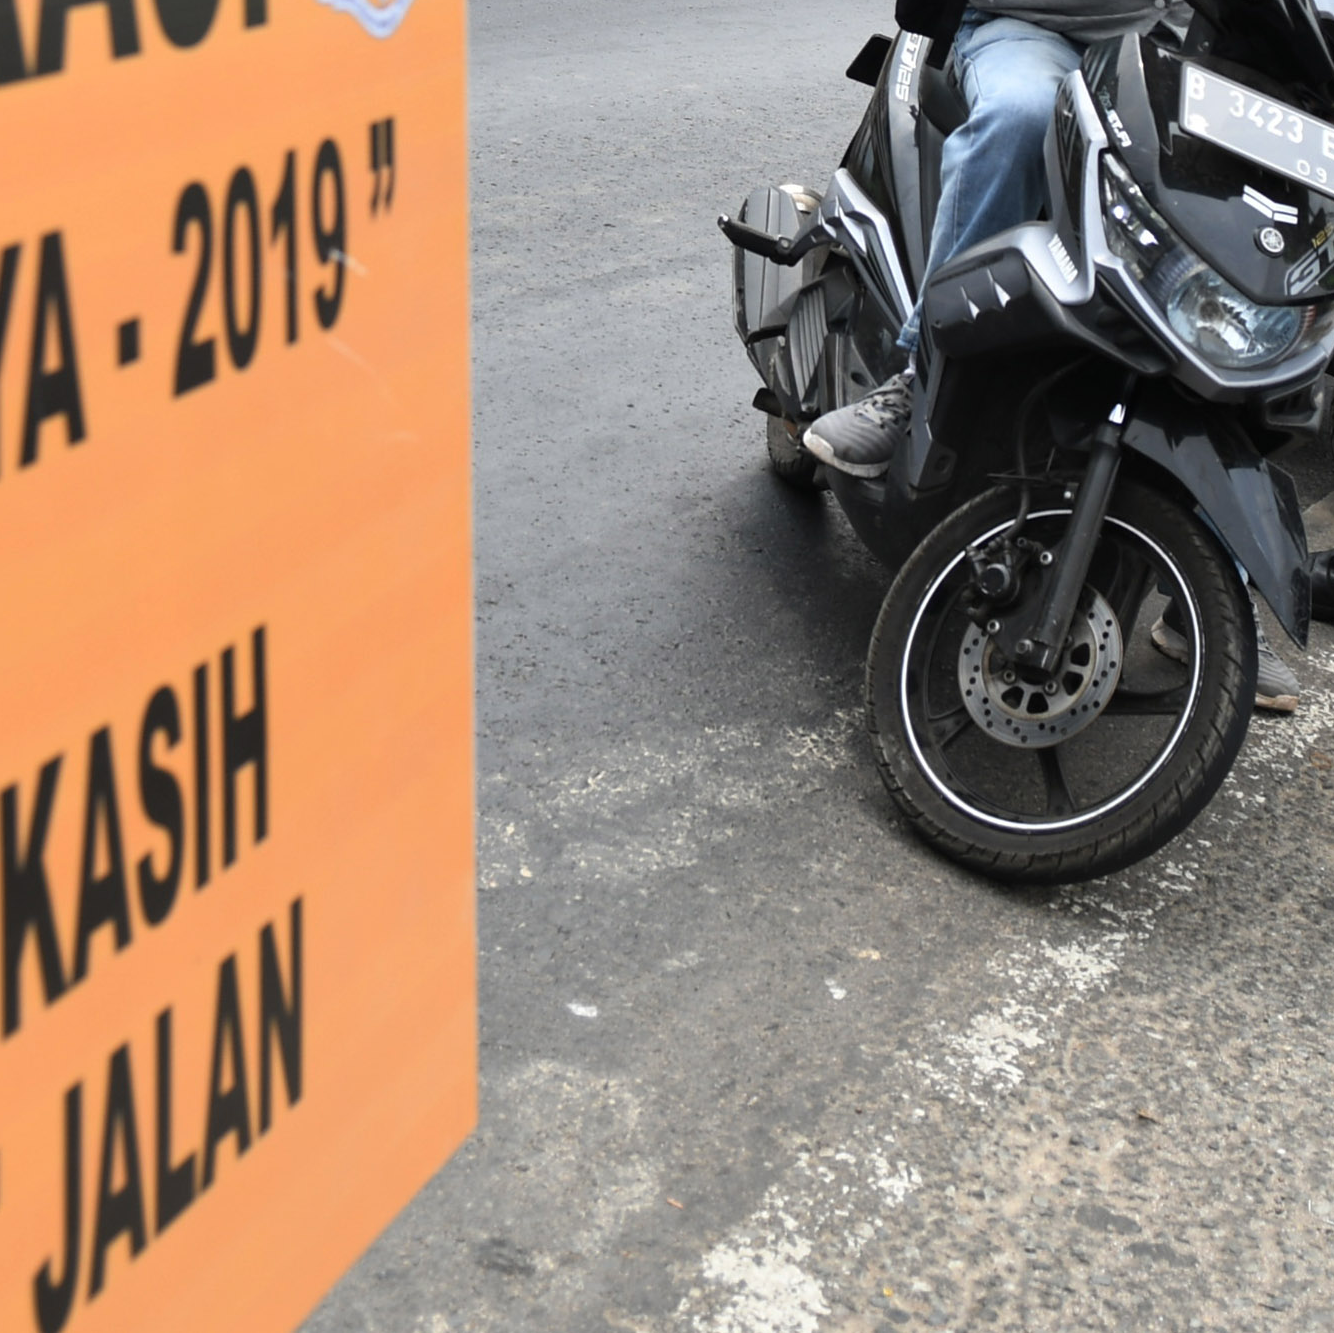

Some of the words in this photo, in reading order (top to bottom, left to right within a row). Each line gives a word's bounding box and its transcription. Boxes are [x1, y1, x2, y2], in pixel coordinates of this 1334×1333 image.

[1187, 72, 1207, 102] B
[1228, 89, 1304, 144] 3423
[169, 135, 348, 401] 2019
[1047, 233, 1079, 284] YAMAHA
[32, 894, 304, 1333] JALAN
